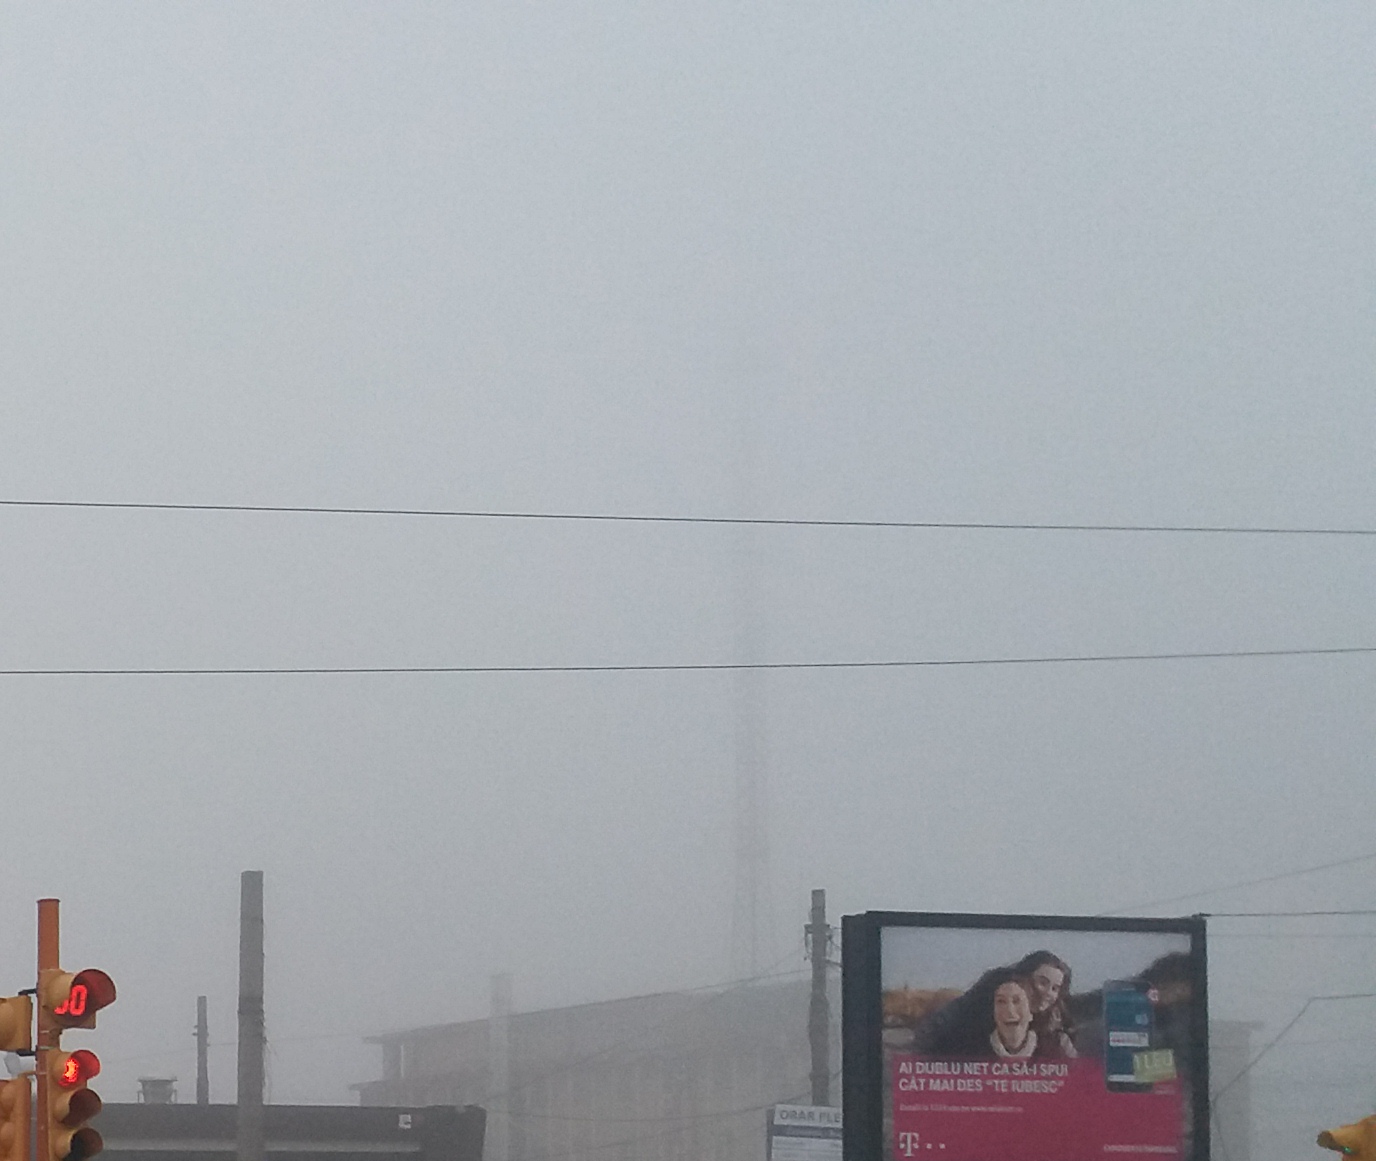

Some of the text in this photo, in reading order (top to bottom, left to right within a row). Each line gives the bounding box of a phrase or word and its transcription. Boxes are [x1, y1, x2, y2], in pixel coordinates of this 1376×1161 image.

[899, 1062, 913, 1075] AI
[916, 1062, 961, 1075] DUBLU
[964, 1062, 989, 1075] NET
[992, 1063, 1009, 1076] CA
[1040, 1063, 1068, 1077] SPUI
[929, 1079, 955, 1092] MAI
[957, 1079, 983, 1092] DES
